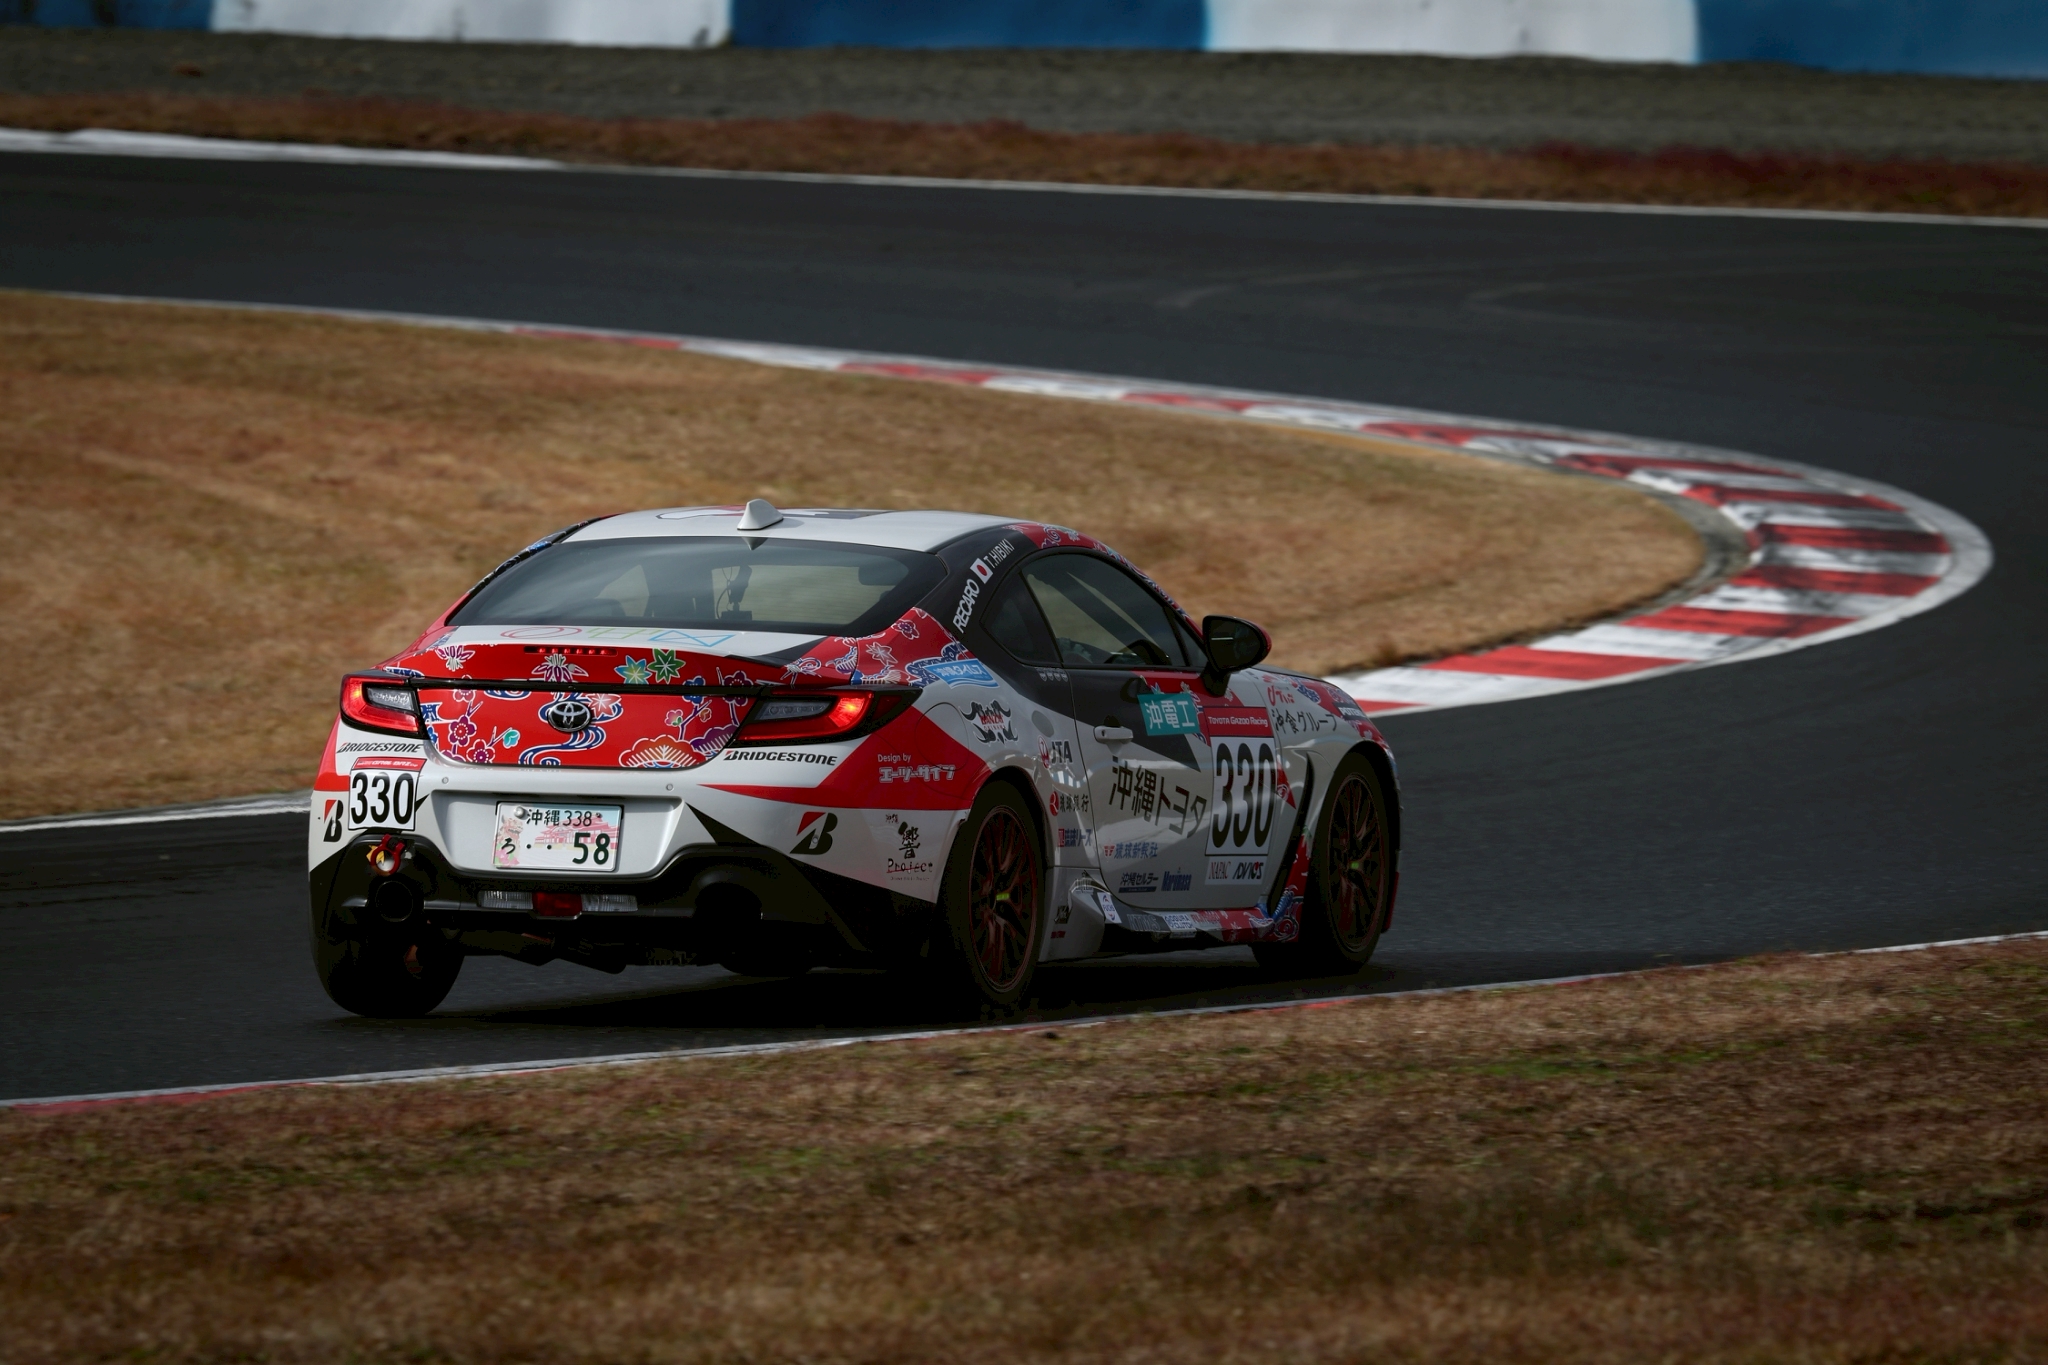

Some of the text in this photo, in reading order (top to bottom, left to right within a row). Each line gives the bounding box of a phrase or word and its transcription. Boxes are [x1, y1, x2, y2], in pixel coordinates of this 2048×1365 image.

[983, 538, 1015, 569] T.HIBIKI
[952, 578, 980, 634] RECARO
[1144, 699, 1196, 730] 沖電工
[1208, 716, 1269, 728] TOYOTA GAZOO Racing
[336, 742, 424, 754] BRIDGESTONE
[1051, 740, 1073, 764] JTA
[723, 750, 838, 766] BRIDGESTONE
[877, 752, 912, 764] Design by
[350, 771, 414, 825] 330
[1108, 755, 1207, 839] 沖縄トヨタ
[1212, 742, 1276, 848] 330
[526, 808, 592, 827] 沖縄 338
[501, 837, 516, 854] ろ
[887, 858, 933, 874] Project
[1209, 860, 1231, 879] NAPAC
